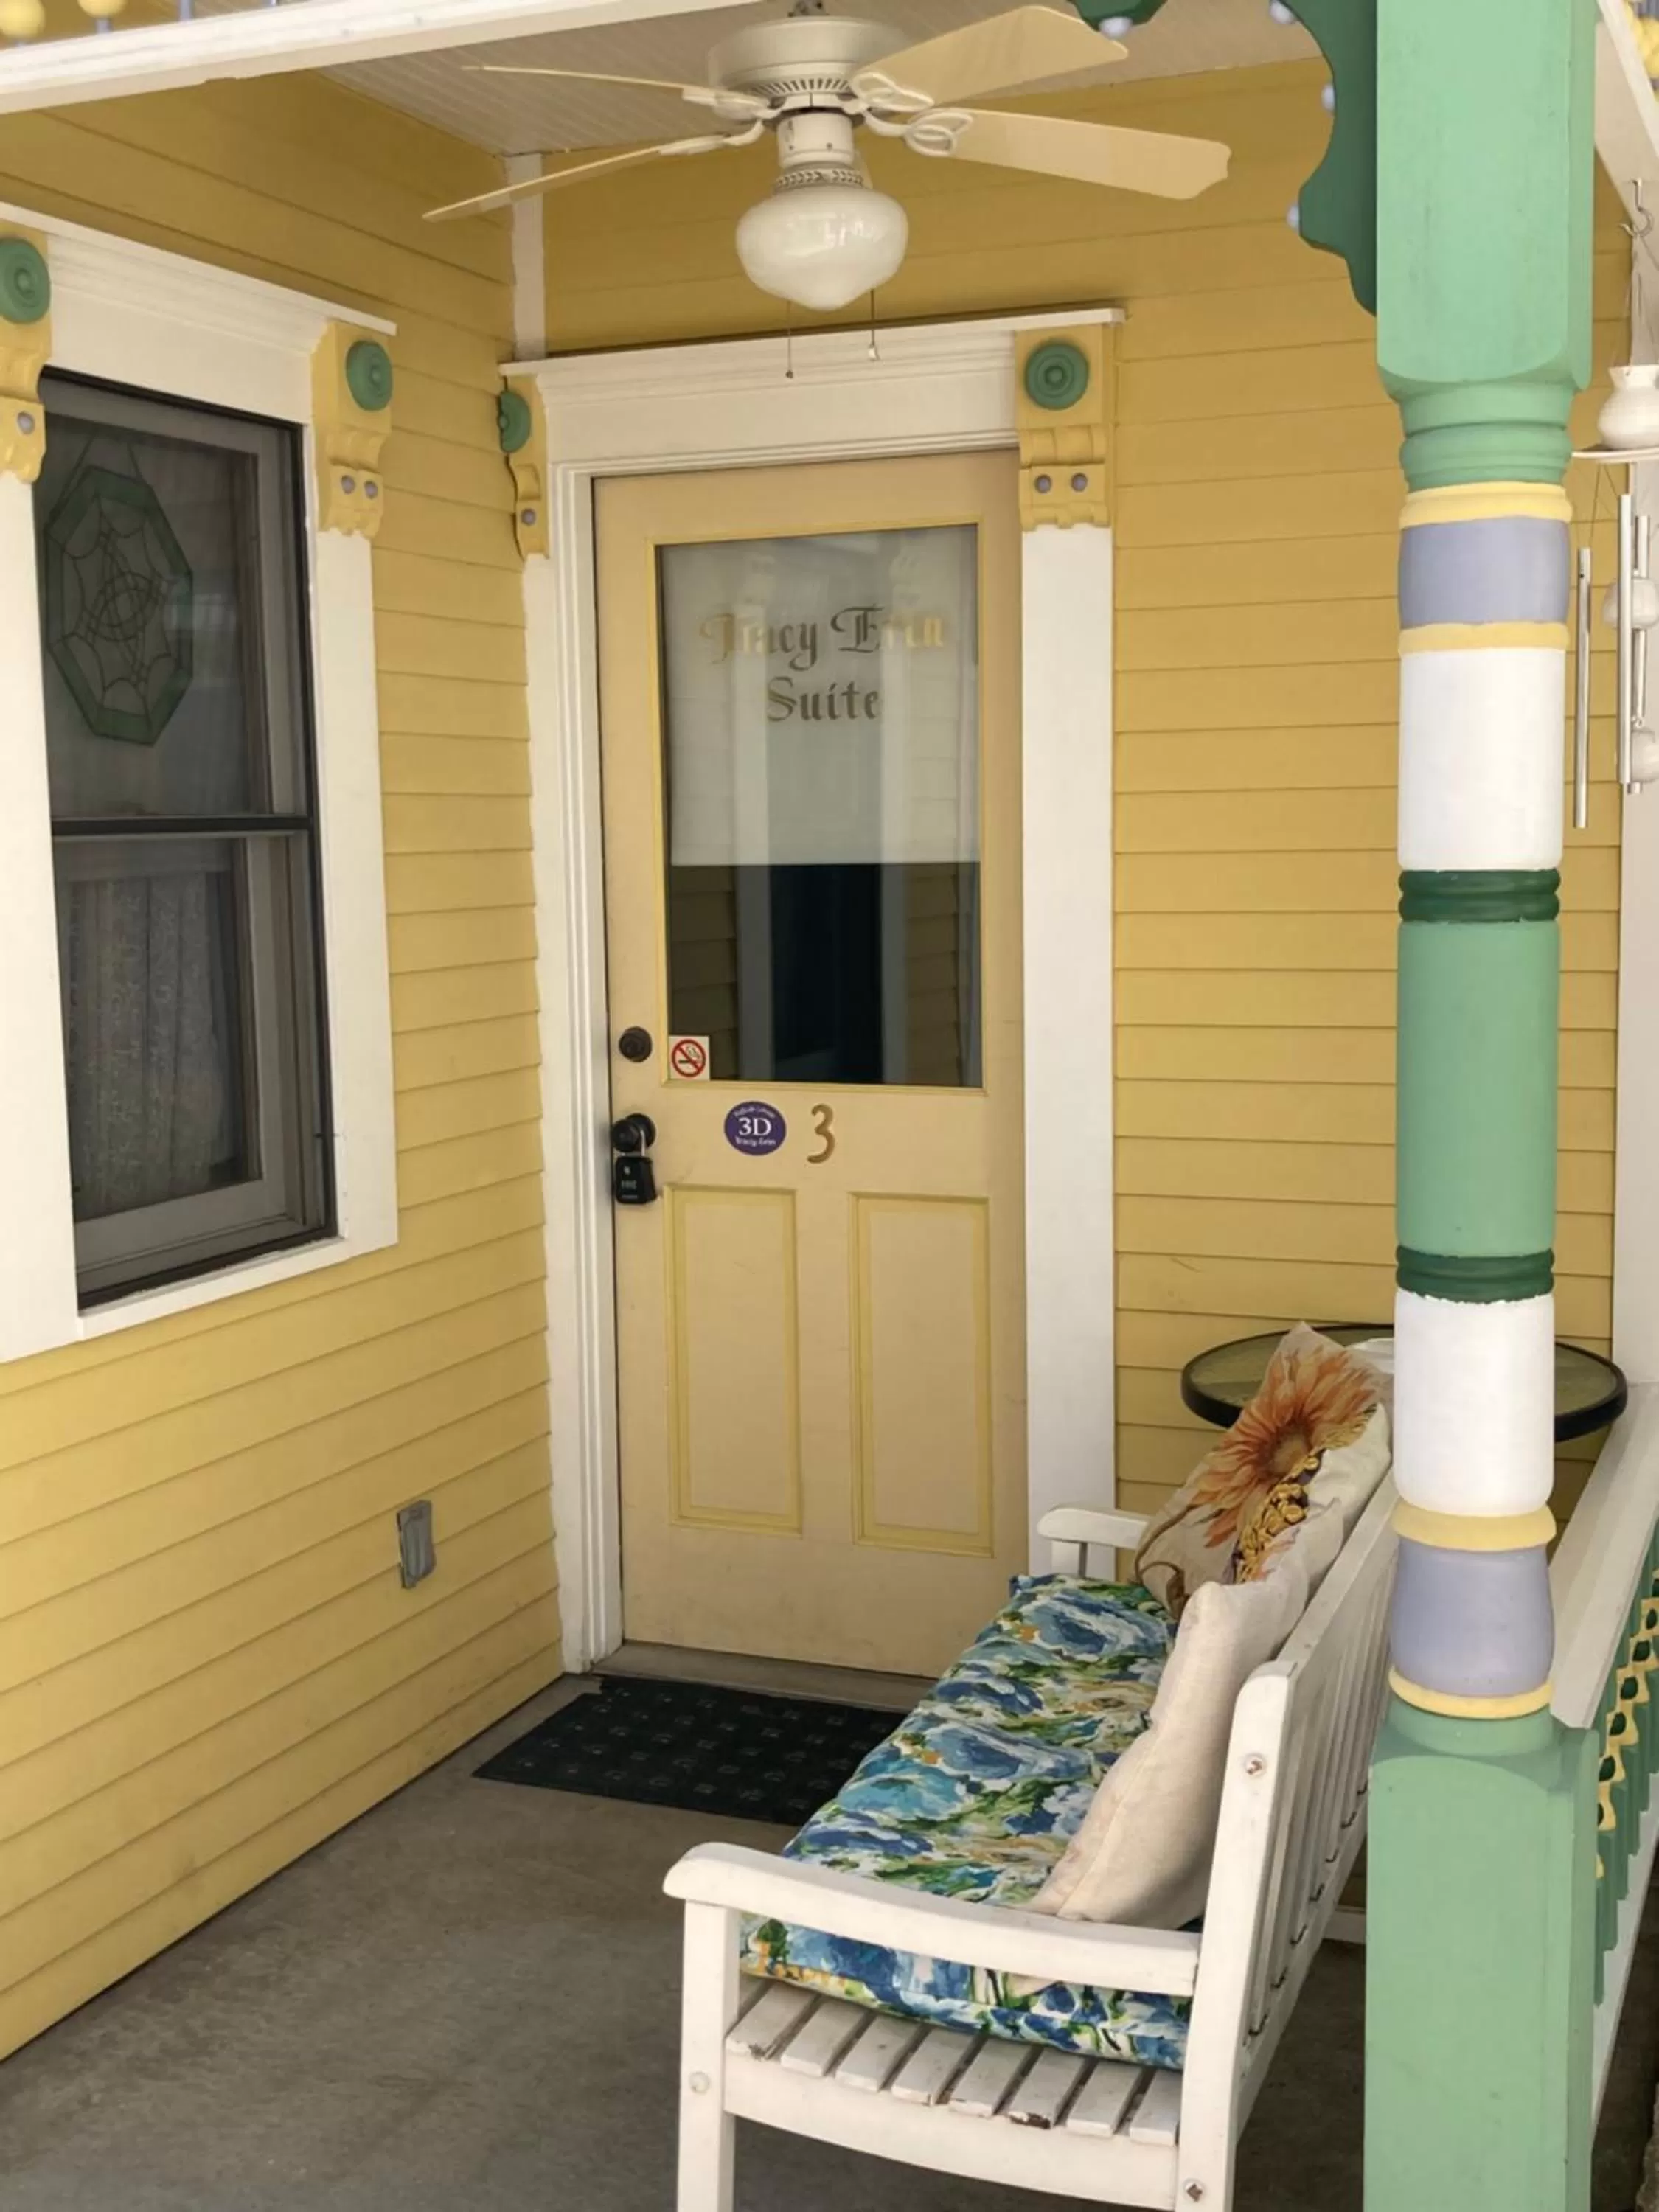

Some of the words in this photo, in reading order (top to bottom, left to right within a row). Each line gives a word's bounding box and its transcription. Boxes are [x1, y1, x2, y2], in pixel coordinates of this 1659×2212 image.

[698, 611, 818, 672] Tracy
[830, 603, 945, 653] Erin
[765, 675, 880, 722] Suite
[738, 1116, 772, 1136] 3D
[806, 1103, 836, 1164] 3
